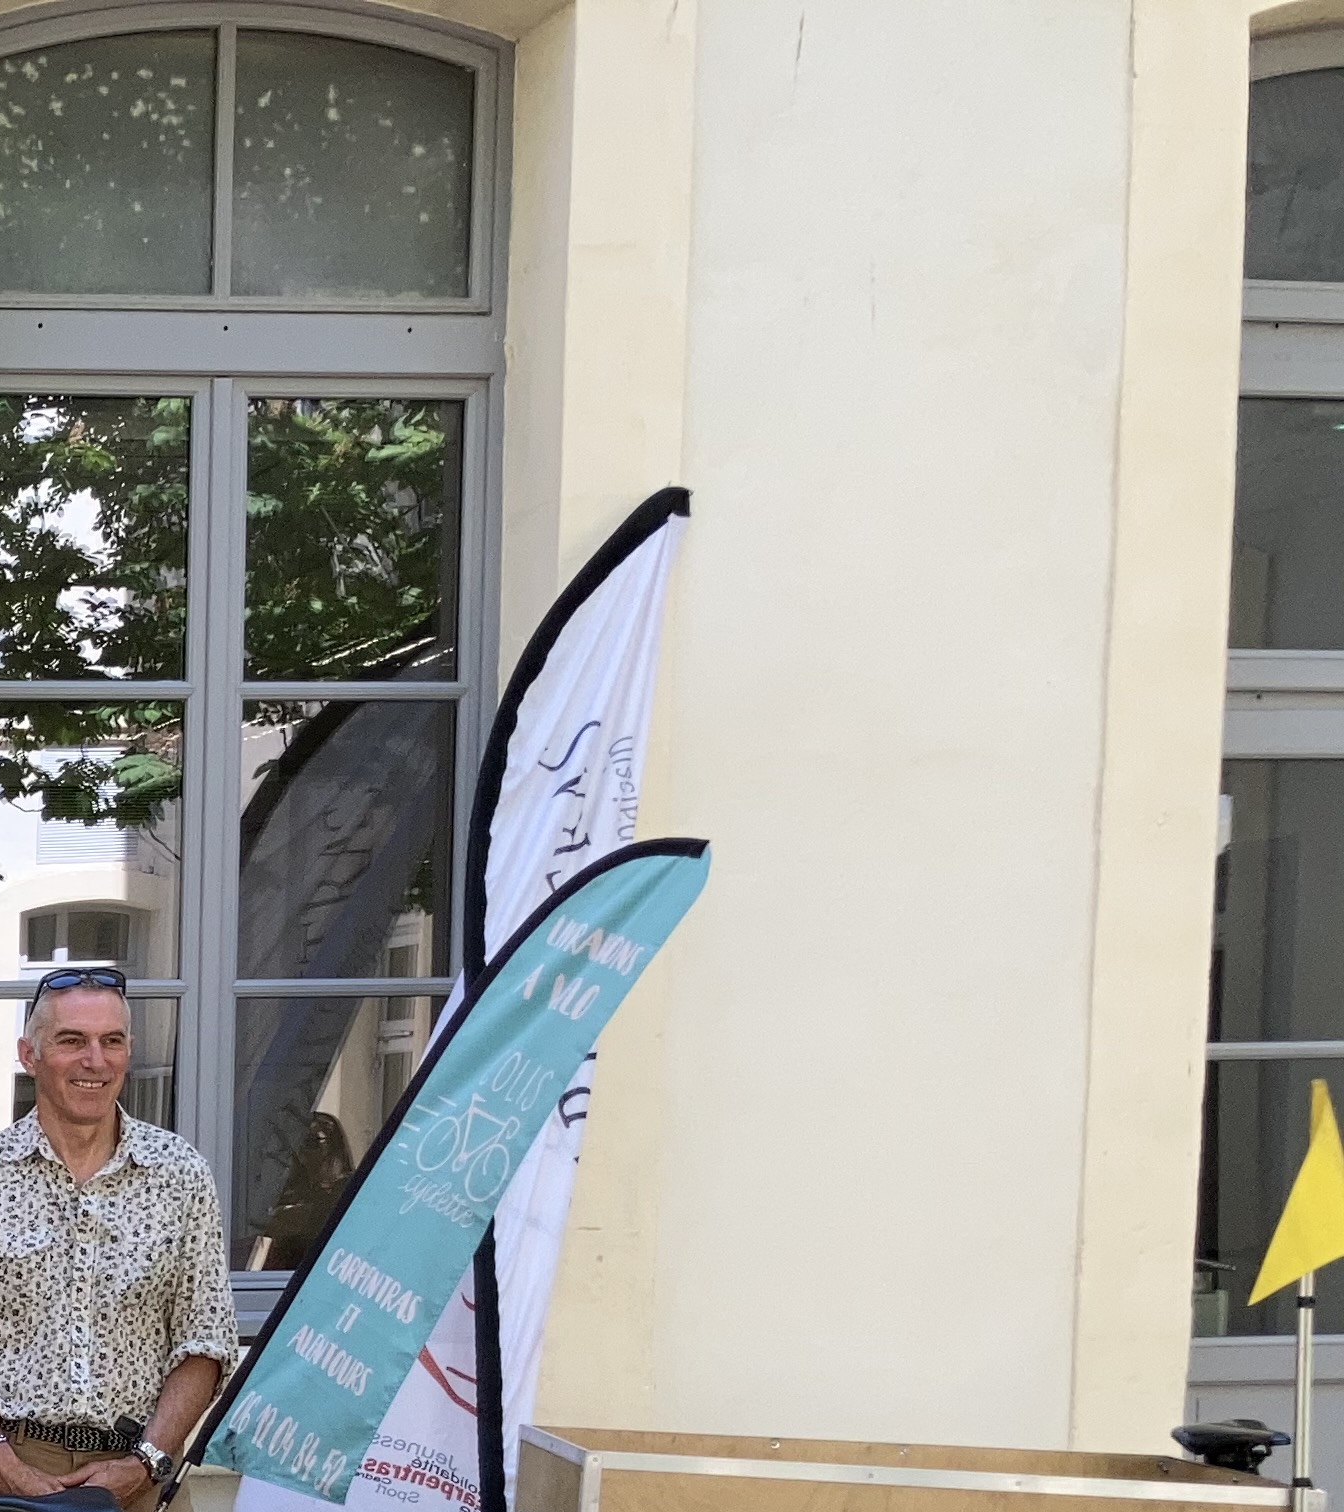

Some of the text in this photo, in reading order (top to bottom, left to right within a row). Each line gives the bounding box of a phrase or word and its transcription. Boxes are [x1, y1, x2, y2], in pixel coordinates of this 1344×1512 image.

[326, 1247, 423, 1324] CARPENTRAS
[335, 1303, 362, 1334] ET
[286, 1324, 374, 1397] ALENTOURS
